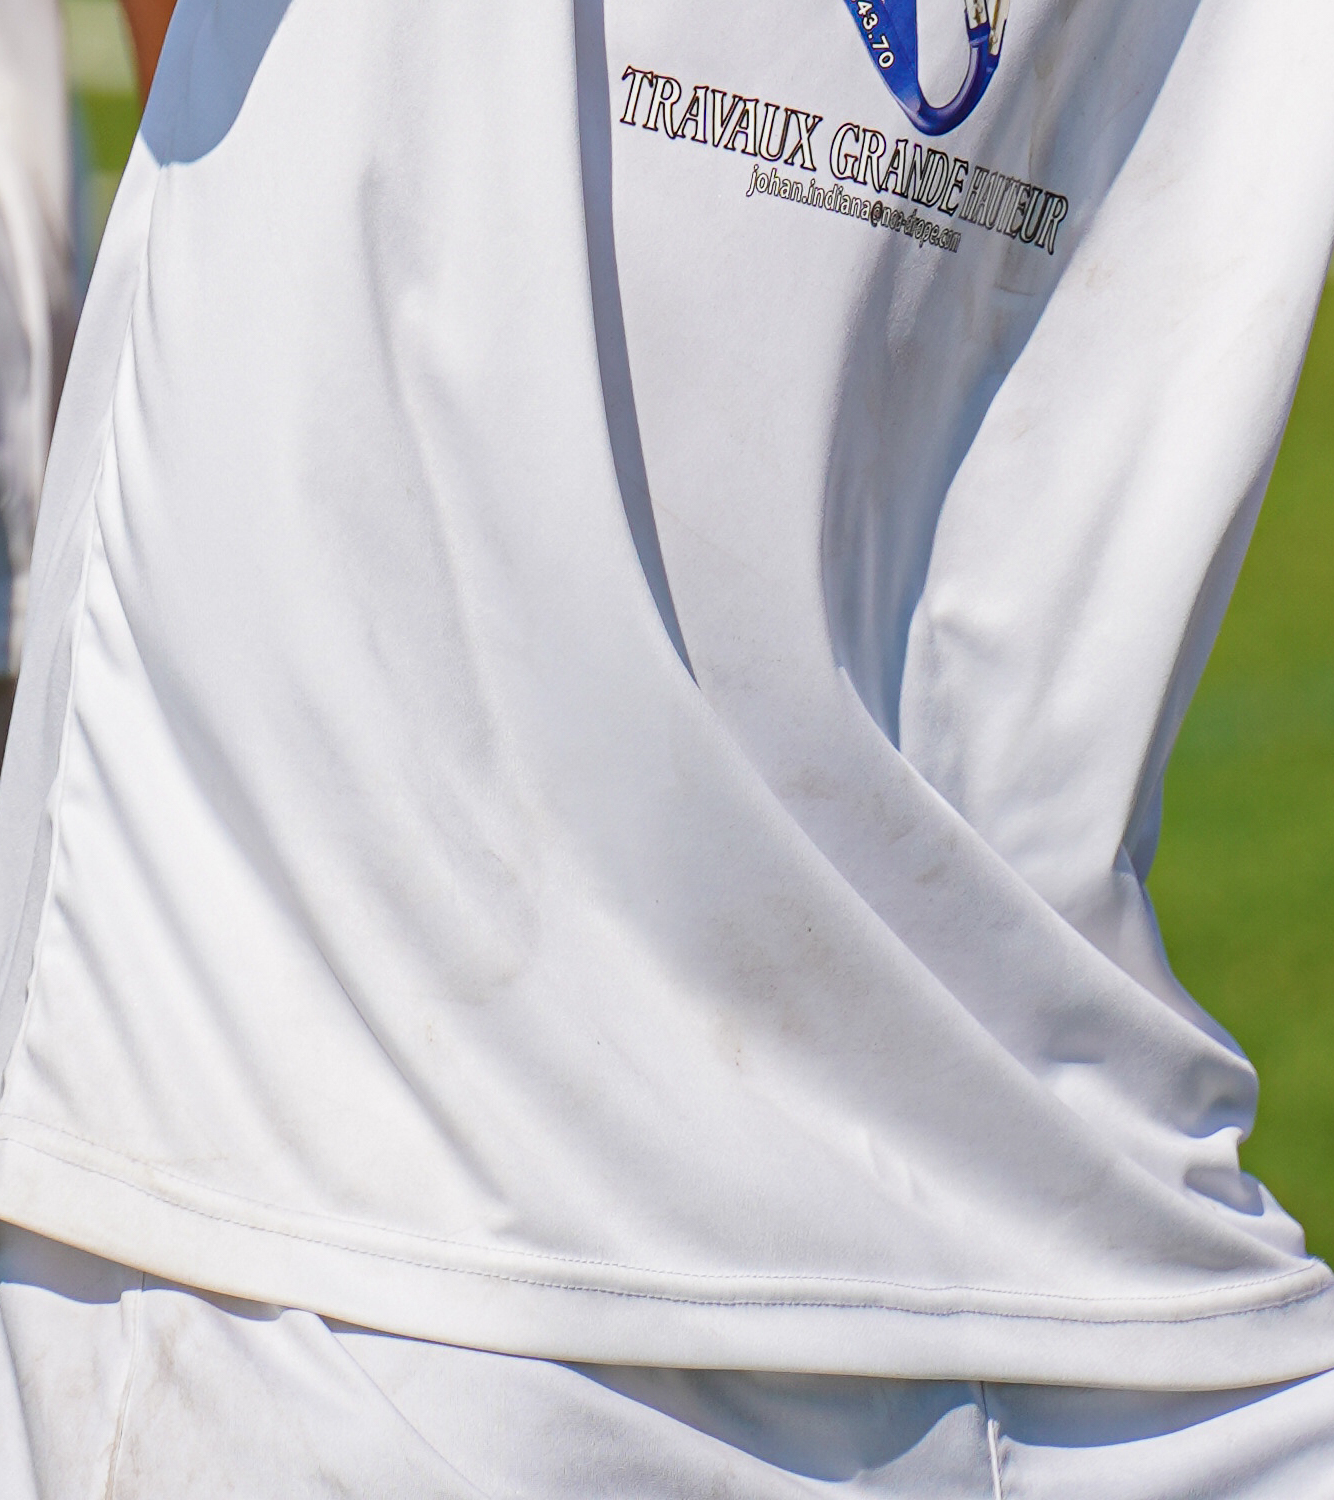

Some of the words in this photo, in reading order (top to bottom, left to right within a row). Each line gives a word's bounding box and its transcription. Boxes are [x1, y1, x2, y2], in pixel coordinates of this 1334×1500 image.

[620, 65, 824, 172] TRAVAUX
[829, 121, 970, 217] GRANDE
[958, 165, 1069, 256] HAUTEUR
